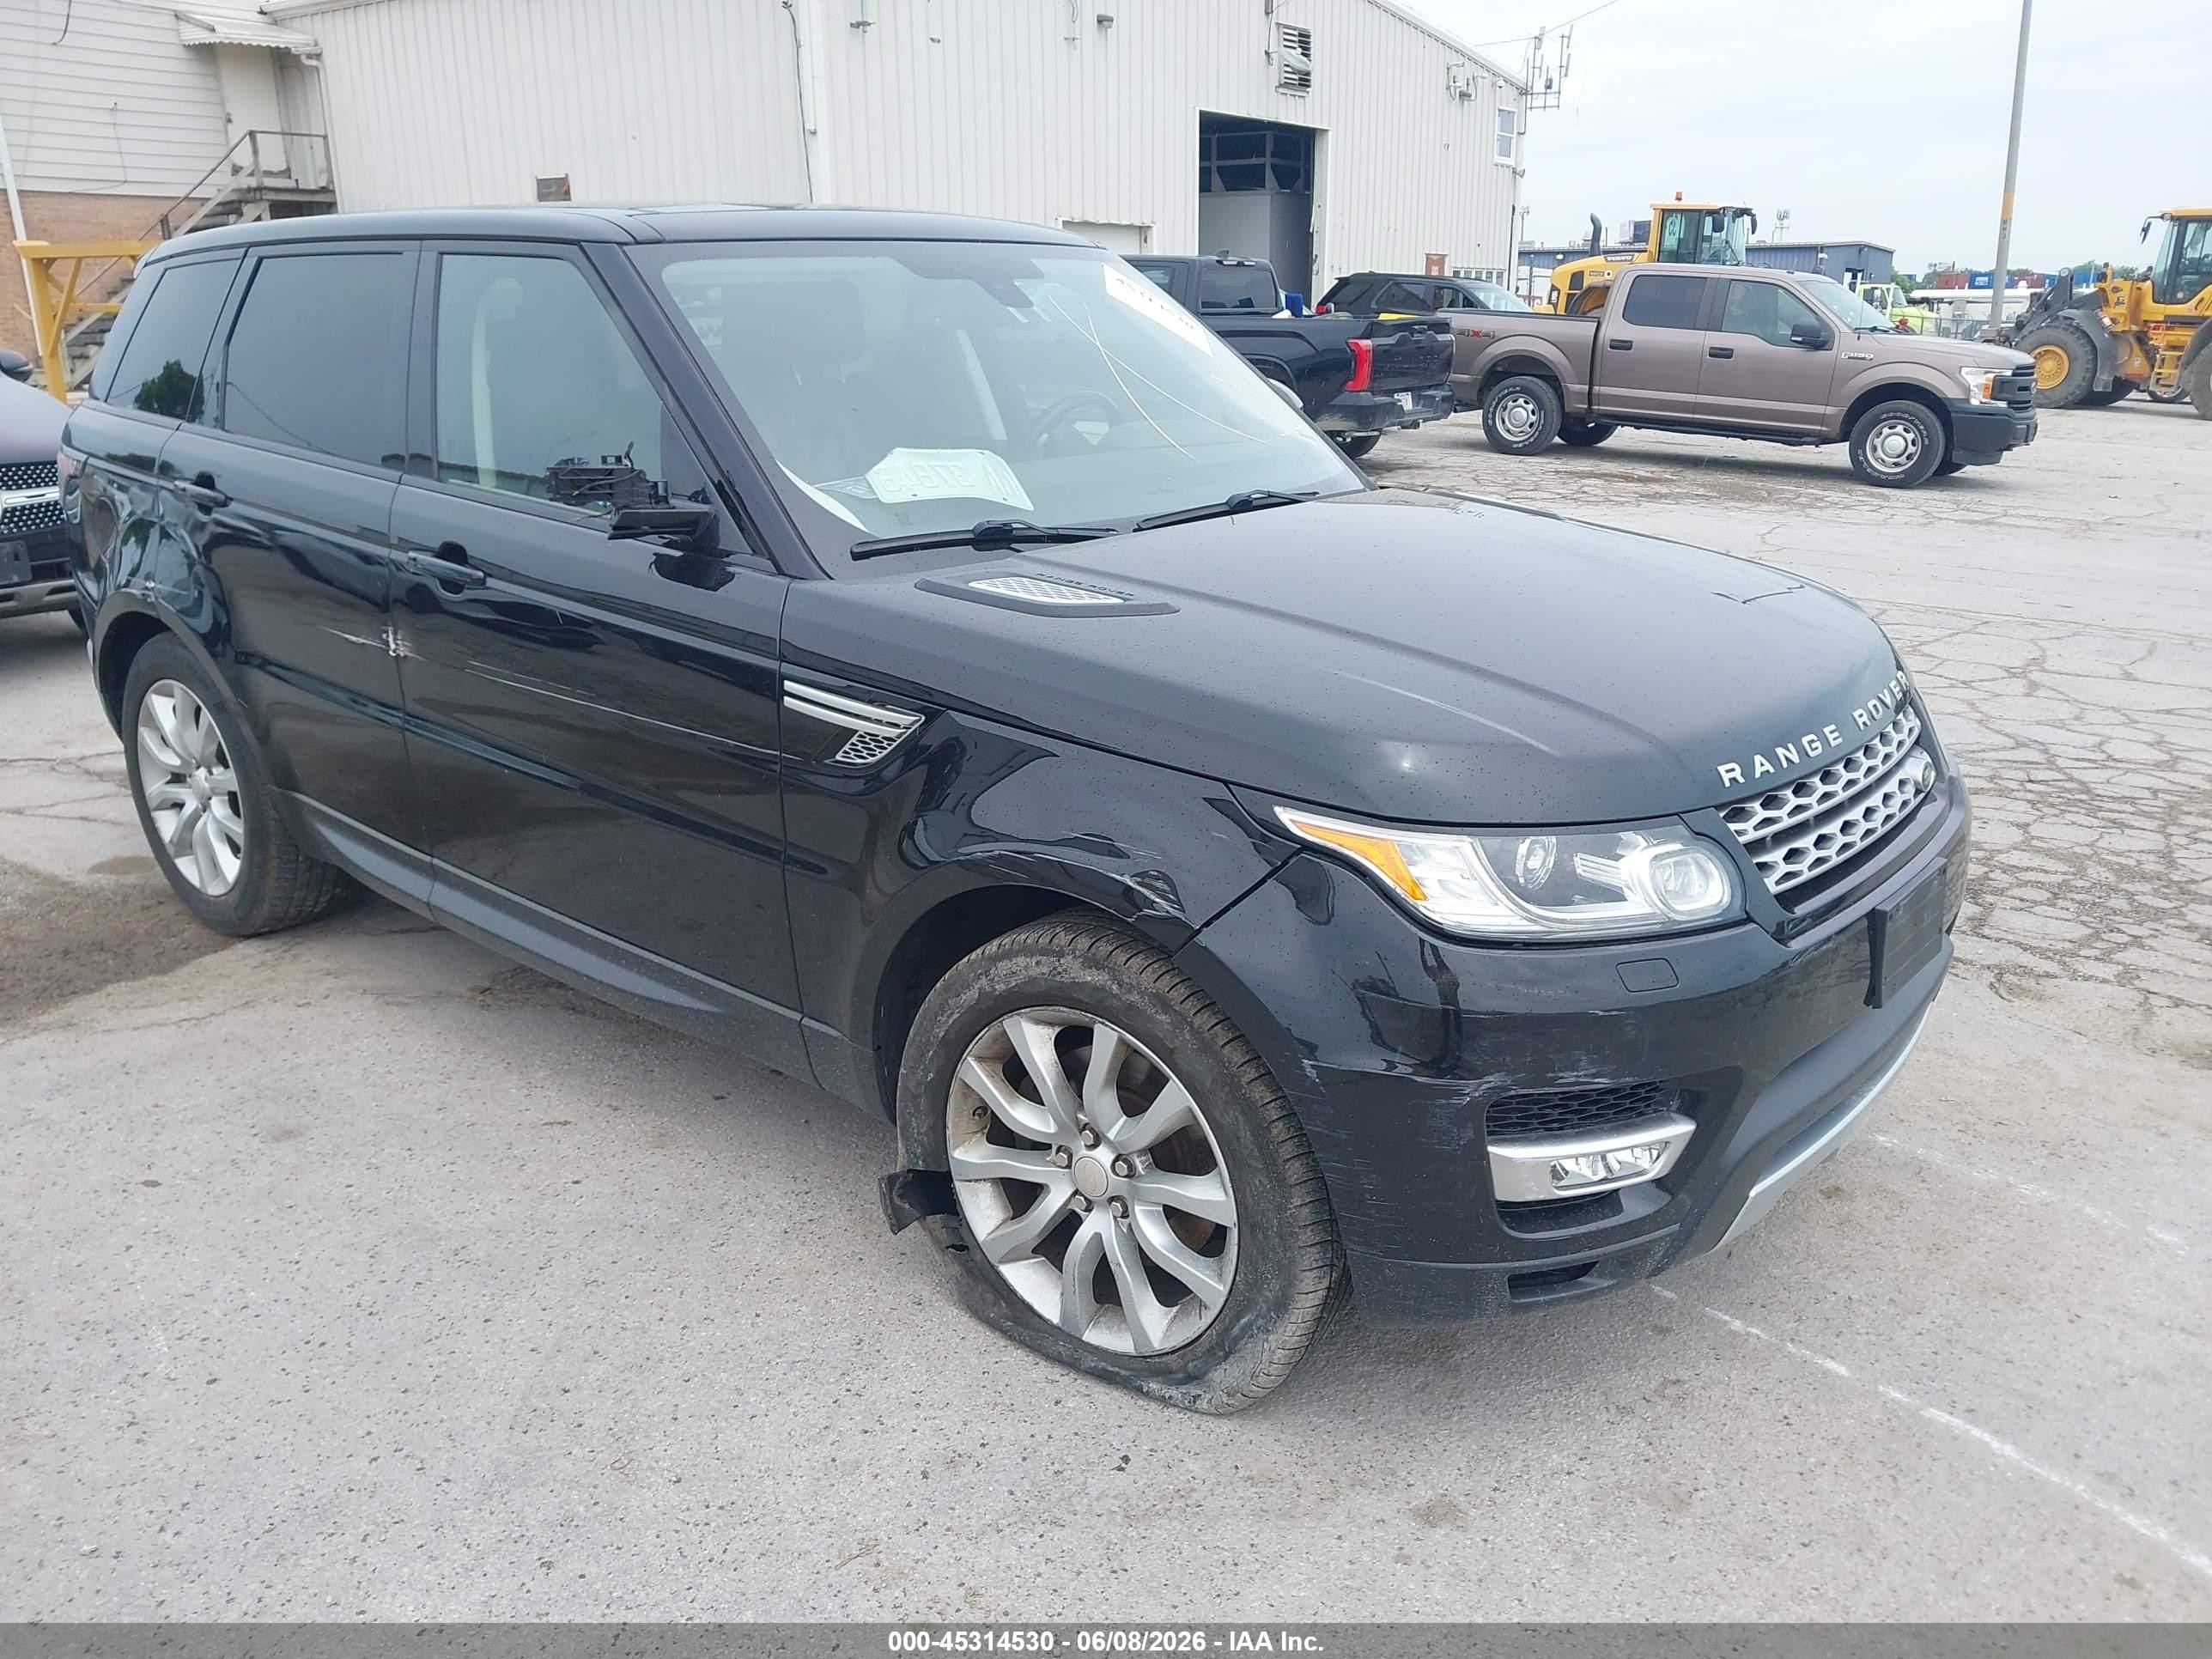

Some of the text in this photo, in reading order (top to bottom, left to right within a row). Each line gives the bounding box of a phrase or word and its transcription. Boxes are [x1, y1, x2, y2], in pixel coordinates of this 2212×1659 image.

[1879, 412, 1929, 445] GOODYEAR
[1036, 573, 1135, 597] RANGE ROVER
[1717, 670, 1910, 788] RANGE ROVER
